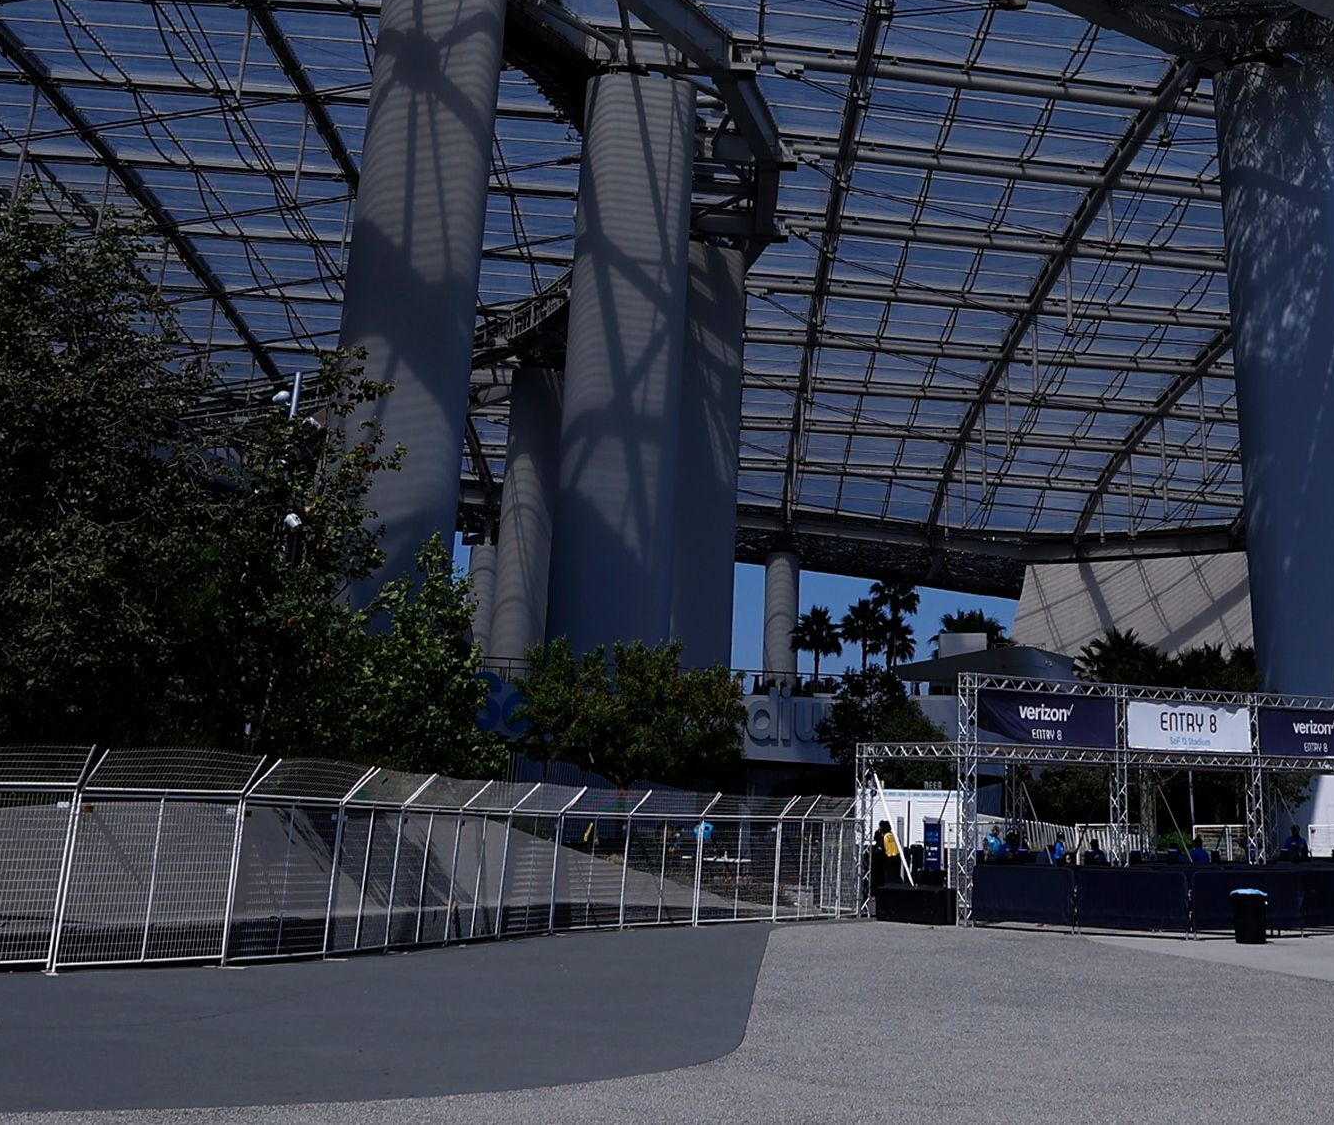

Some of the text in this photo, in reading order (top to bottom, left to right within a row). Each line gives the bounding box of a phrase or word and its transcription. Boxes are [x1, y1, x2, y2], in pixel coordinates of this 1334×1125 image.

[1019, 703, 1067, 722] verizon
[1160, 712, 1217, 733] ENTRY 8
[1292, 719, 1331, 735] verizon
[1031, 728, 1063, 741] ENTRY 8
